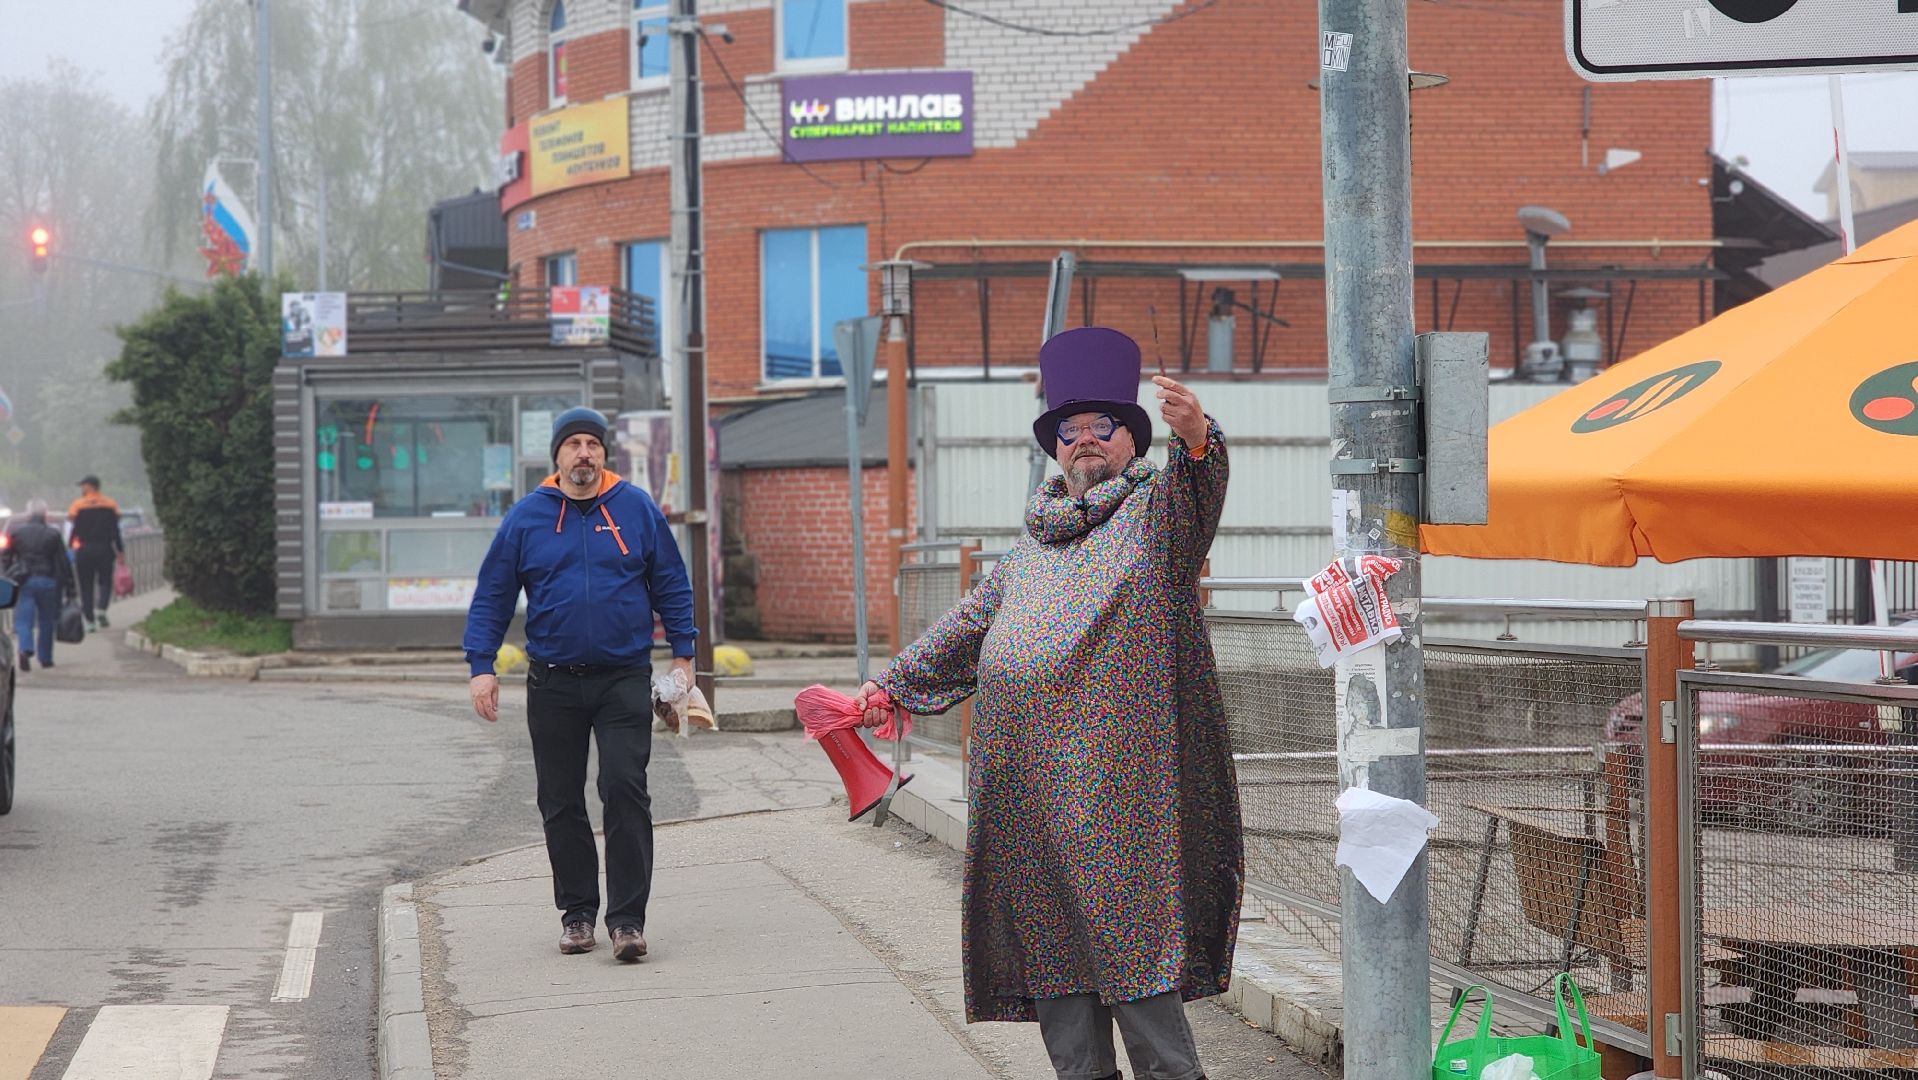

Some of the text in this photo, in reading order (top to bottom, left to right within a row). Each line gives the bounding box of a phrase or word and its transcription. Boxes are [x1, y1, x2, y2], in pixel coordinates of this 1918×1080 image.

[835, 93, 963, 122] ВИНЛАБ
[790, 119, 962, 139] СУПЕРМАРКЕТ НАПИТКОВ
[1356, 584, 1380, 635] ВЫСТАВКА
